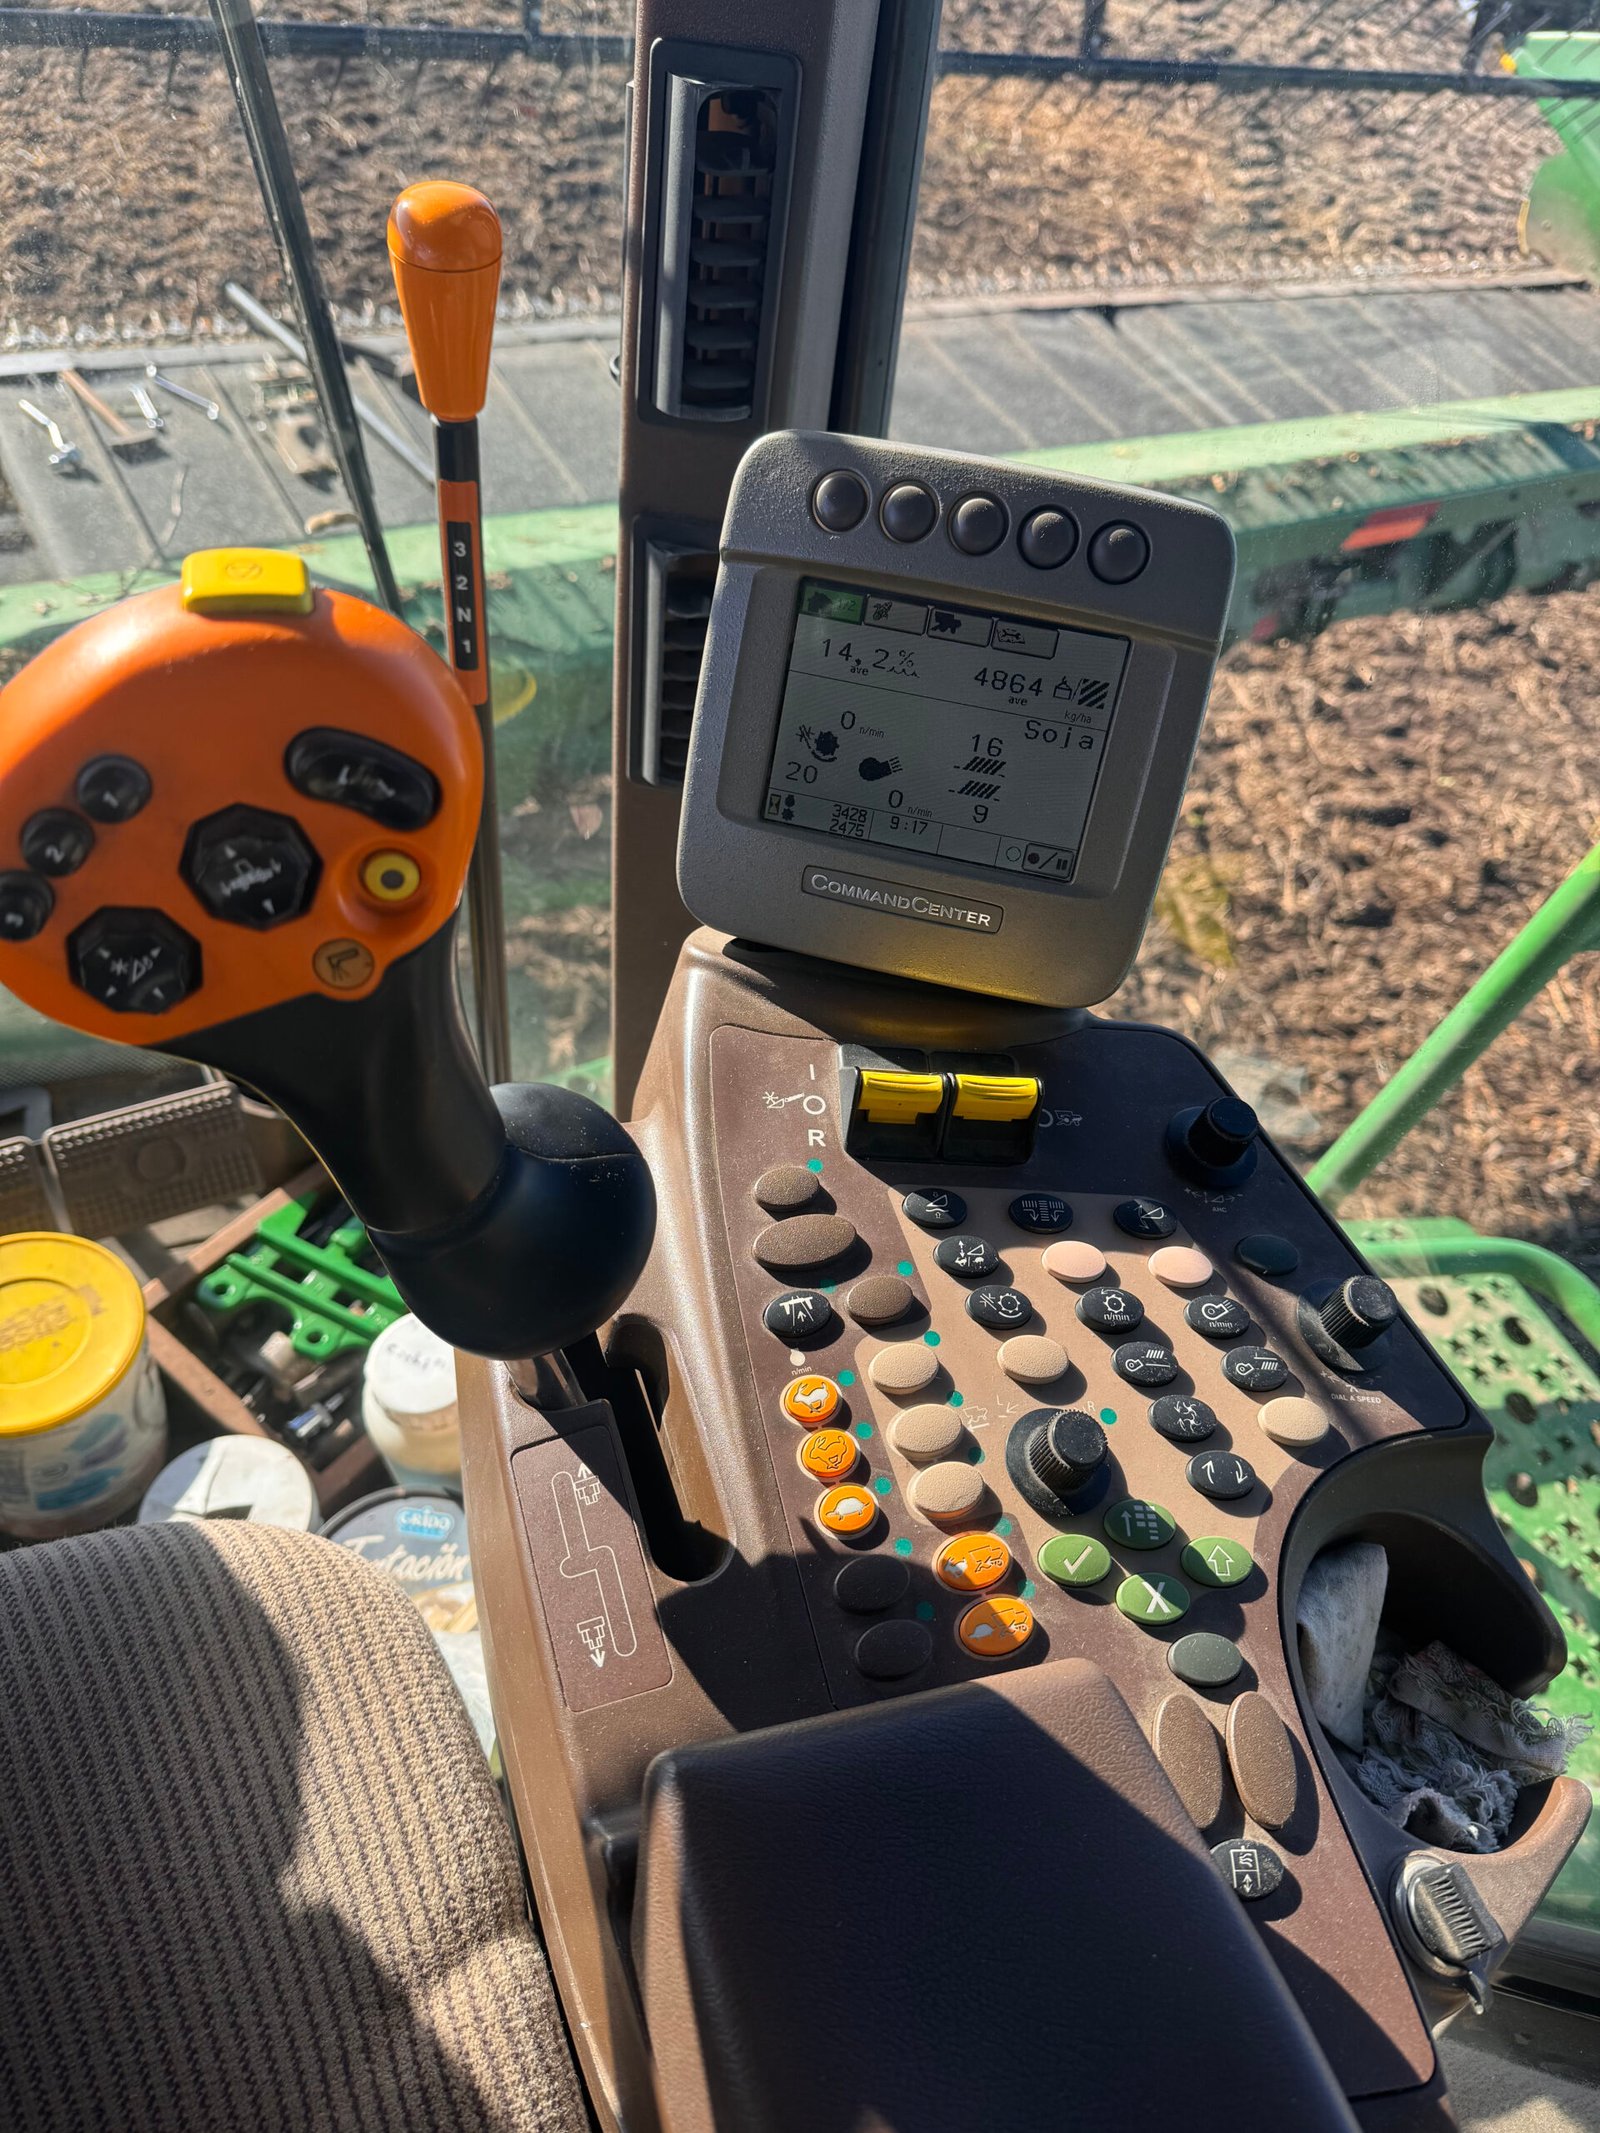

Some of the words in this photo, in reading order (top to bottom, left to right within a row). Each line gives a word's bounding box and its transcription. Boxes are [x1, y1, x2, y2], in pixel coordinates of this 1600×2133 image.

[454, 542, 467, 557] 3
[456, 575, 468, 590] 2
[457, 607, 472, 622] N
[462, 639, 472, 654] 1
[850, 665, 869, 677] ave
[974, 667, 1043, 697] 4864
[1008, 695, 1028, 706] ave
[840, 710, 856, 730] 0
[859, 726, 884, 738] n/min
[1024, 720, 1094, 750] Soja
[971, 733, 1004, 757] 16
[785, 761, 818, 784] 20
[888, 789, 904, 809] 0
[907, 805, 933, 818] n/min
[832, 804, 868, 823] 3428
[972, 804, 989, 824] 9
[829, 818, 865, 837] 2475
[889, 816, 928, 836] 9:17
[807, 1128, 827, 1147] R
[1103, 1312, 1131, 1322] n/min
[1208, 1320, 1233, 1329] n/min
[791, 1365, 812, 1376] n/min
[1086, 1400, 1096, 1412] R
[1357, 1395, 1382, 1404] SPEED
